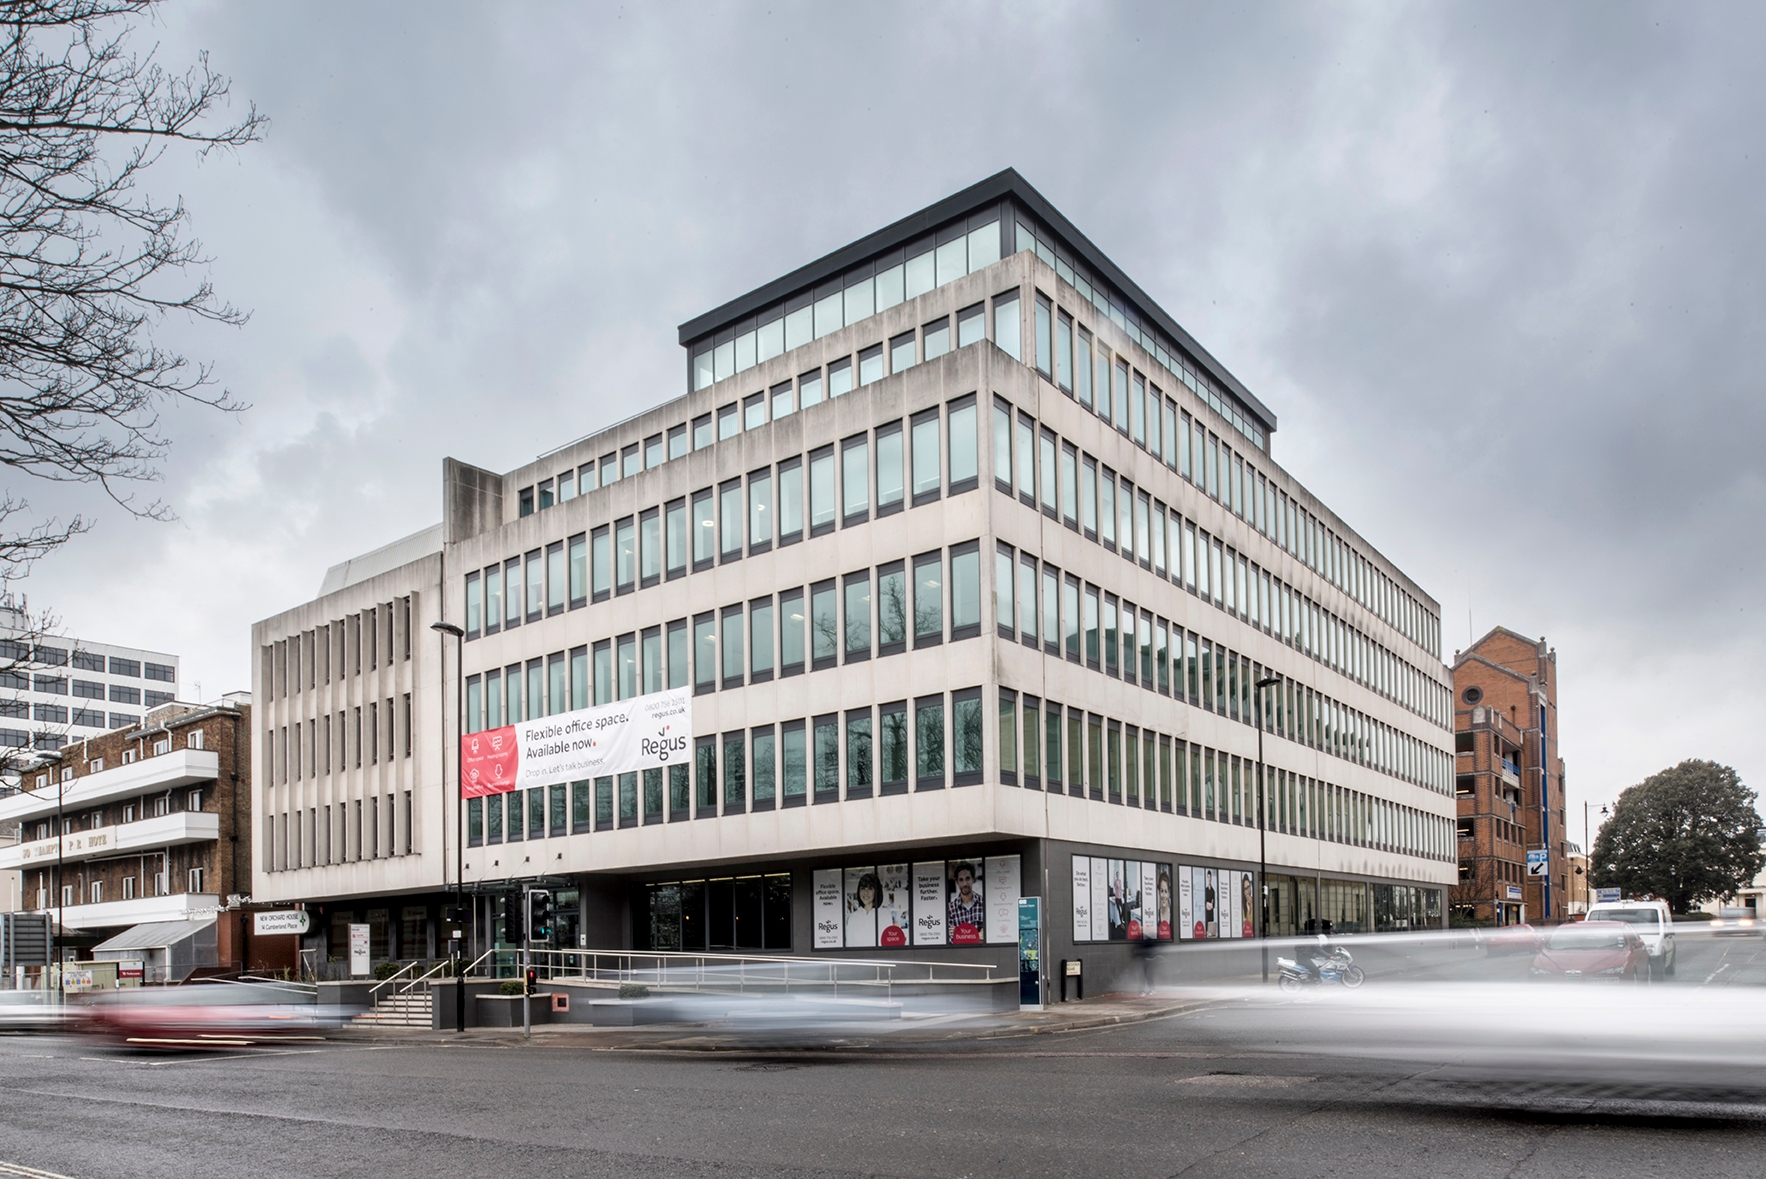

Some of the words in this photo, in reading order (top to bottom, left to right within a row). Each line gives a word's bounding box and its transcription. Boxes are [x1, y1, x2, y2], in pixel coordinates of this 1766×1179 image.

[652, 706, 685, 720] regus.co.uk
[526, 725, 562, 742] Flexible
[565, 719, 592, 735] office
[595, 713, 629, 730] space.
[526, 741, 570, 759] Available
[572, 739, 597, 751] now.
[641, 735, 687, 761] Regus
[525, 768, 540, 778] Drop
[549, 763, 564, 774] Let's
[565, 762, 577, 771] talk
[1540, 853, 1547, 862] P
[819, 922, 838, 933] Regus
[919, 917, 941, 929] Regus
